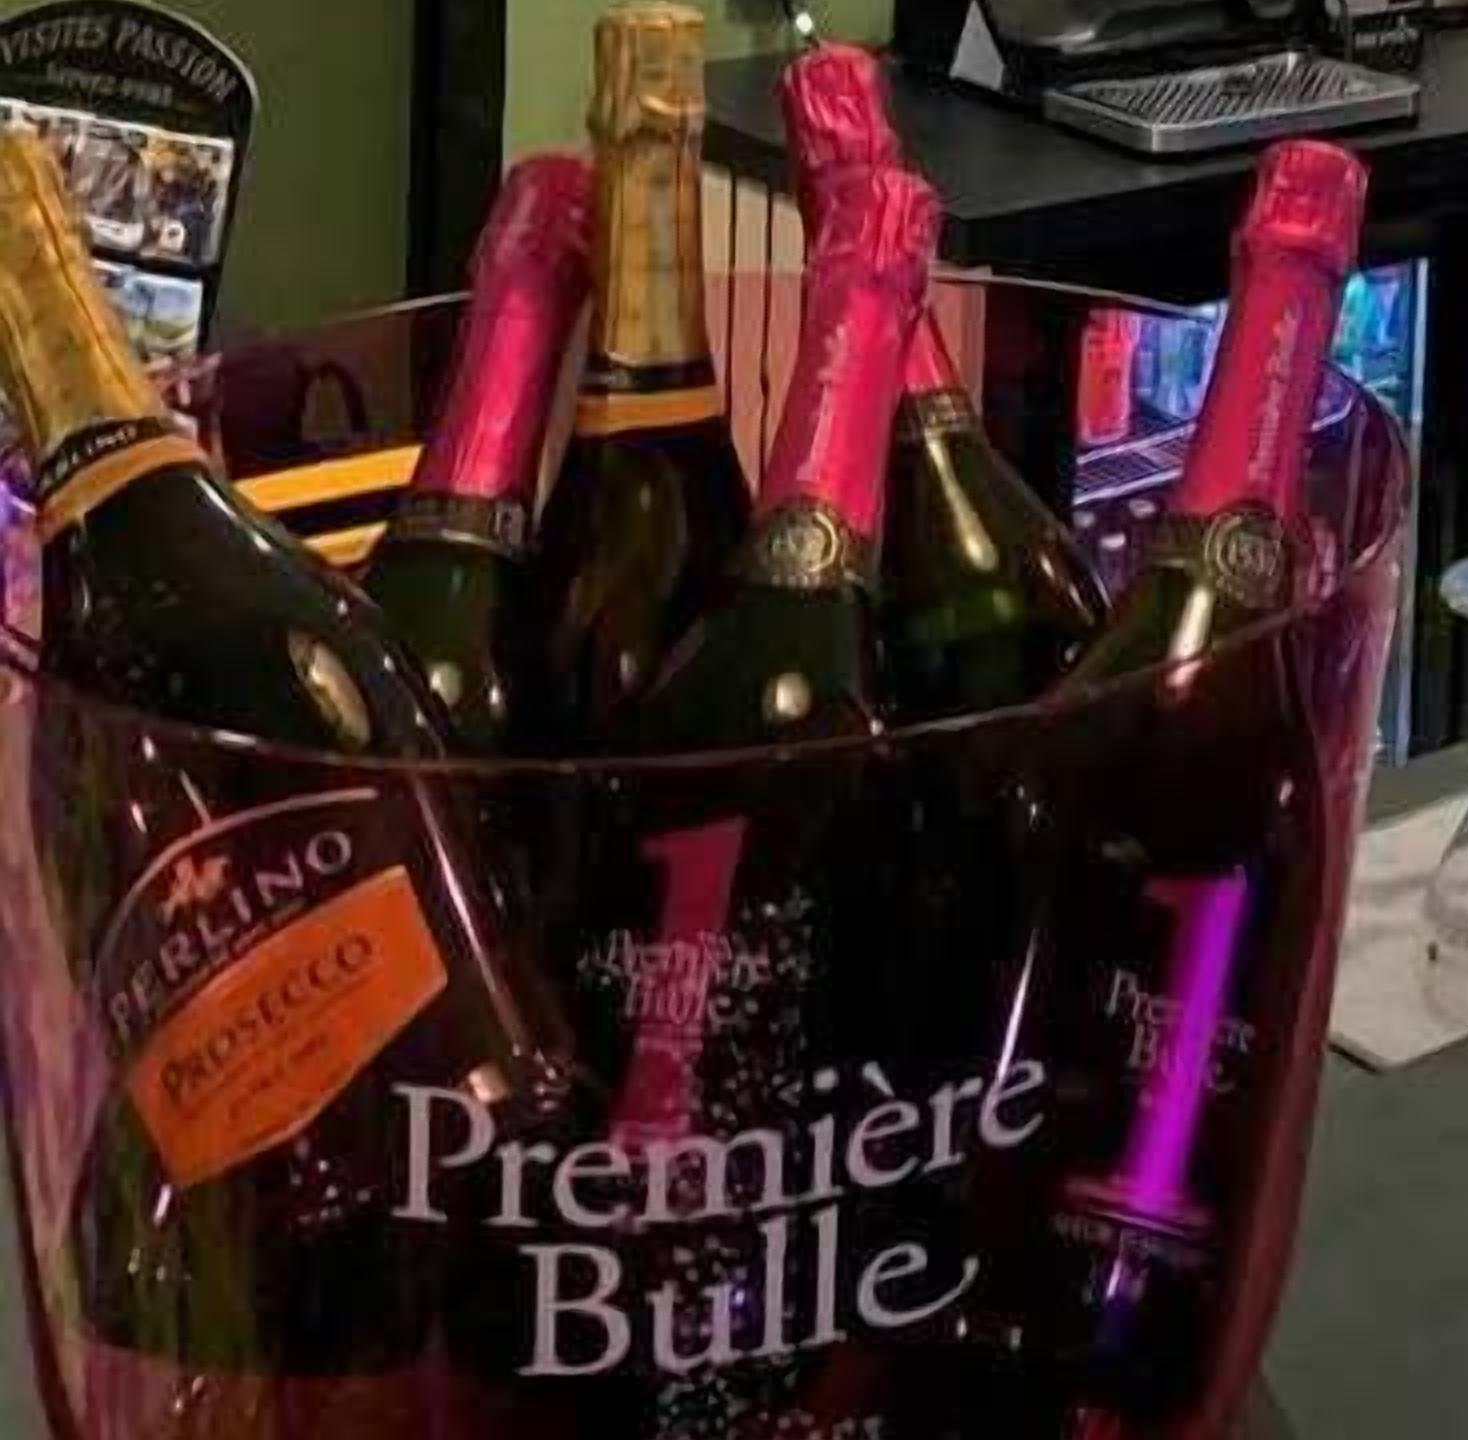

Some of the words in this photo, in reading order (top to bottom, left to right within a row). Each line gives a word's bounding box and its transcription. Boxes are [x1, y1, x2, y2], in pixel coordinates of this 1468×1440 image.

[0, 14, 112, 65] VISITES
[114, 18, 240, 105] PASSION
[107, 829, 352, 1044] PERLINO
[159, 932, 373, 1109] PROSECCO
[390, 1055, 1048, 1233] Première
[517, 1203, 980, 1381] Bulle
